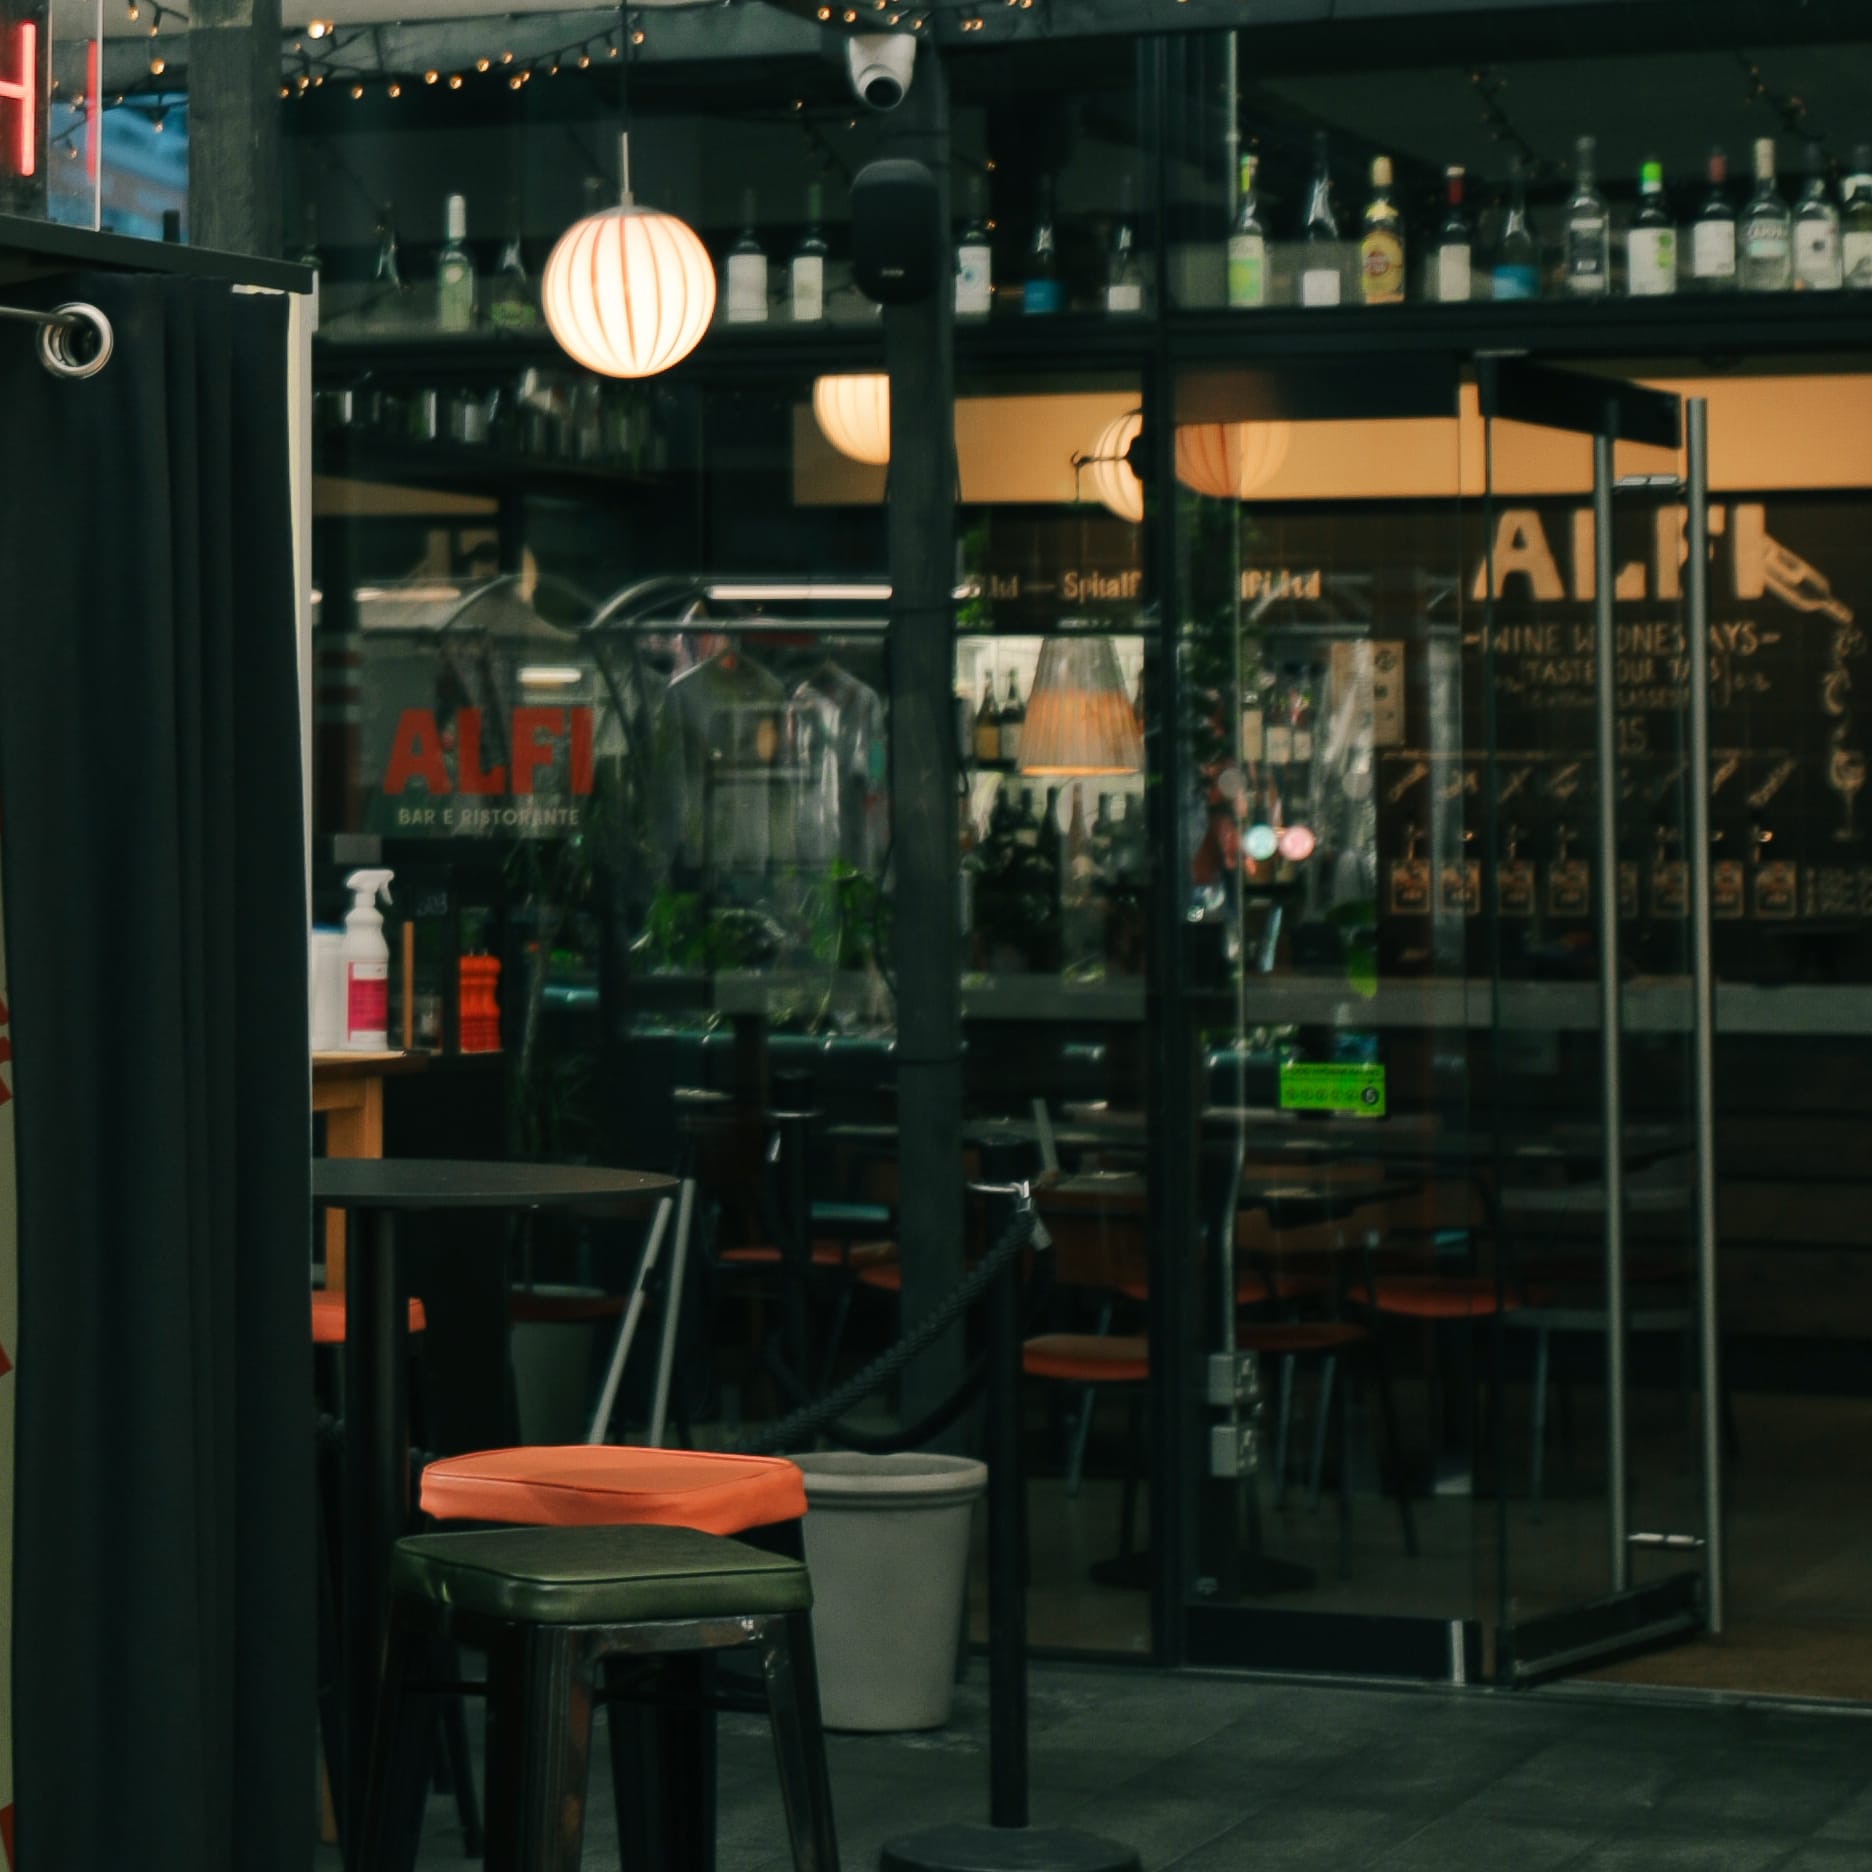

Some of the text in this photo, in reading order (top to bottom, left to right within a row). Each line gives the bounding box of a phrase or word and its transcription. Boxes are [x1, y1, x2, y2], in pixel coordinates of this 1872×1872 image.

[1472, 503, 1766, 603] ALFI
[383, 707, 594, 796] ALFI
[398, 807, 436, 826] BAR
[461, 808, 580, 827] RISTORANTE
